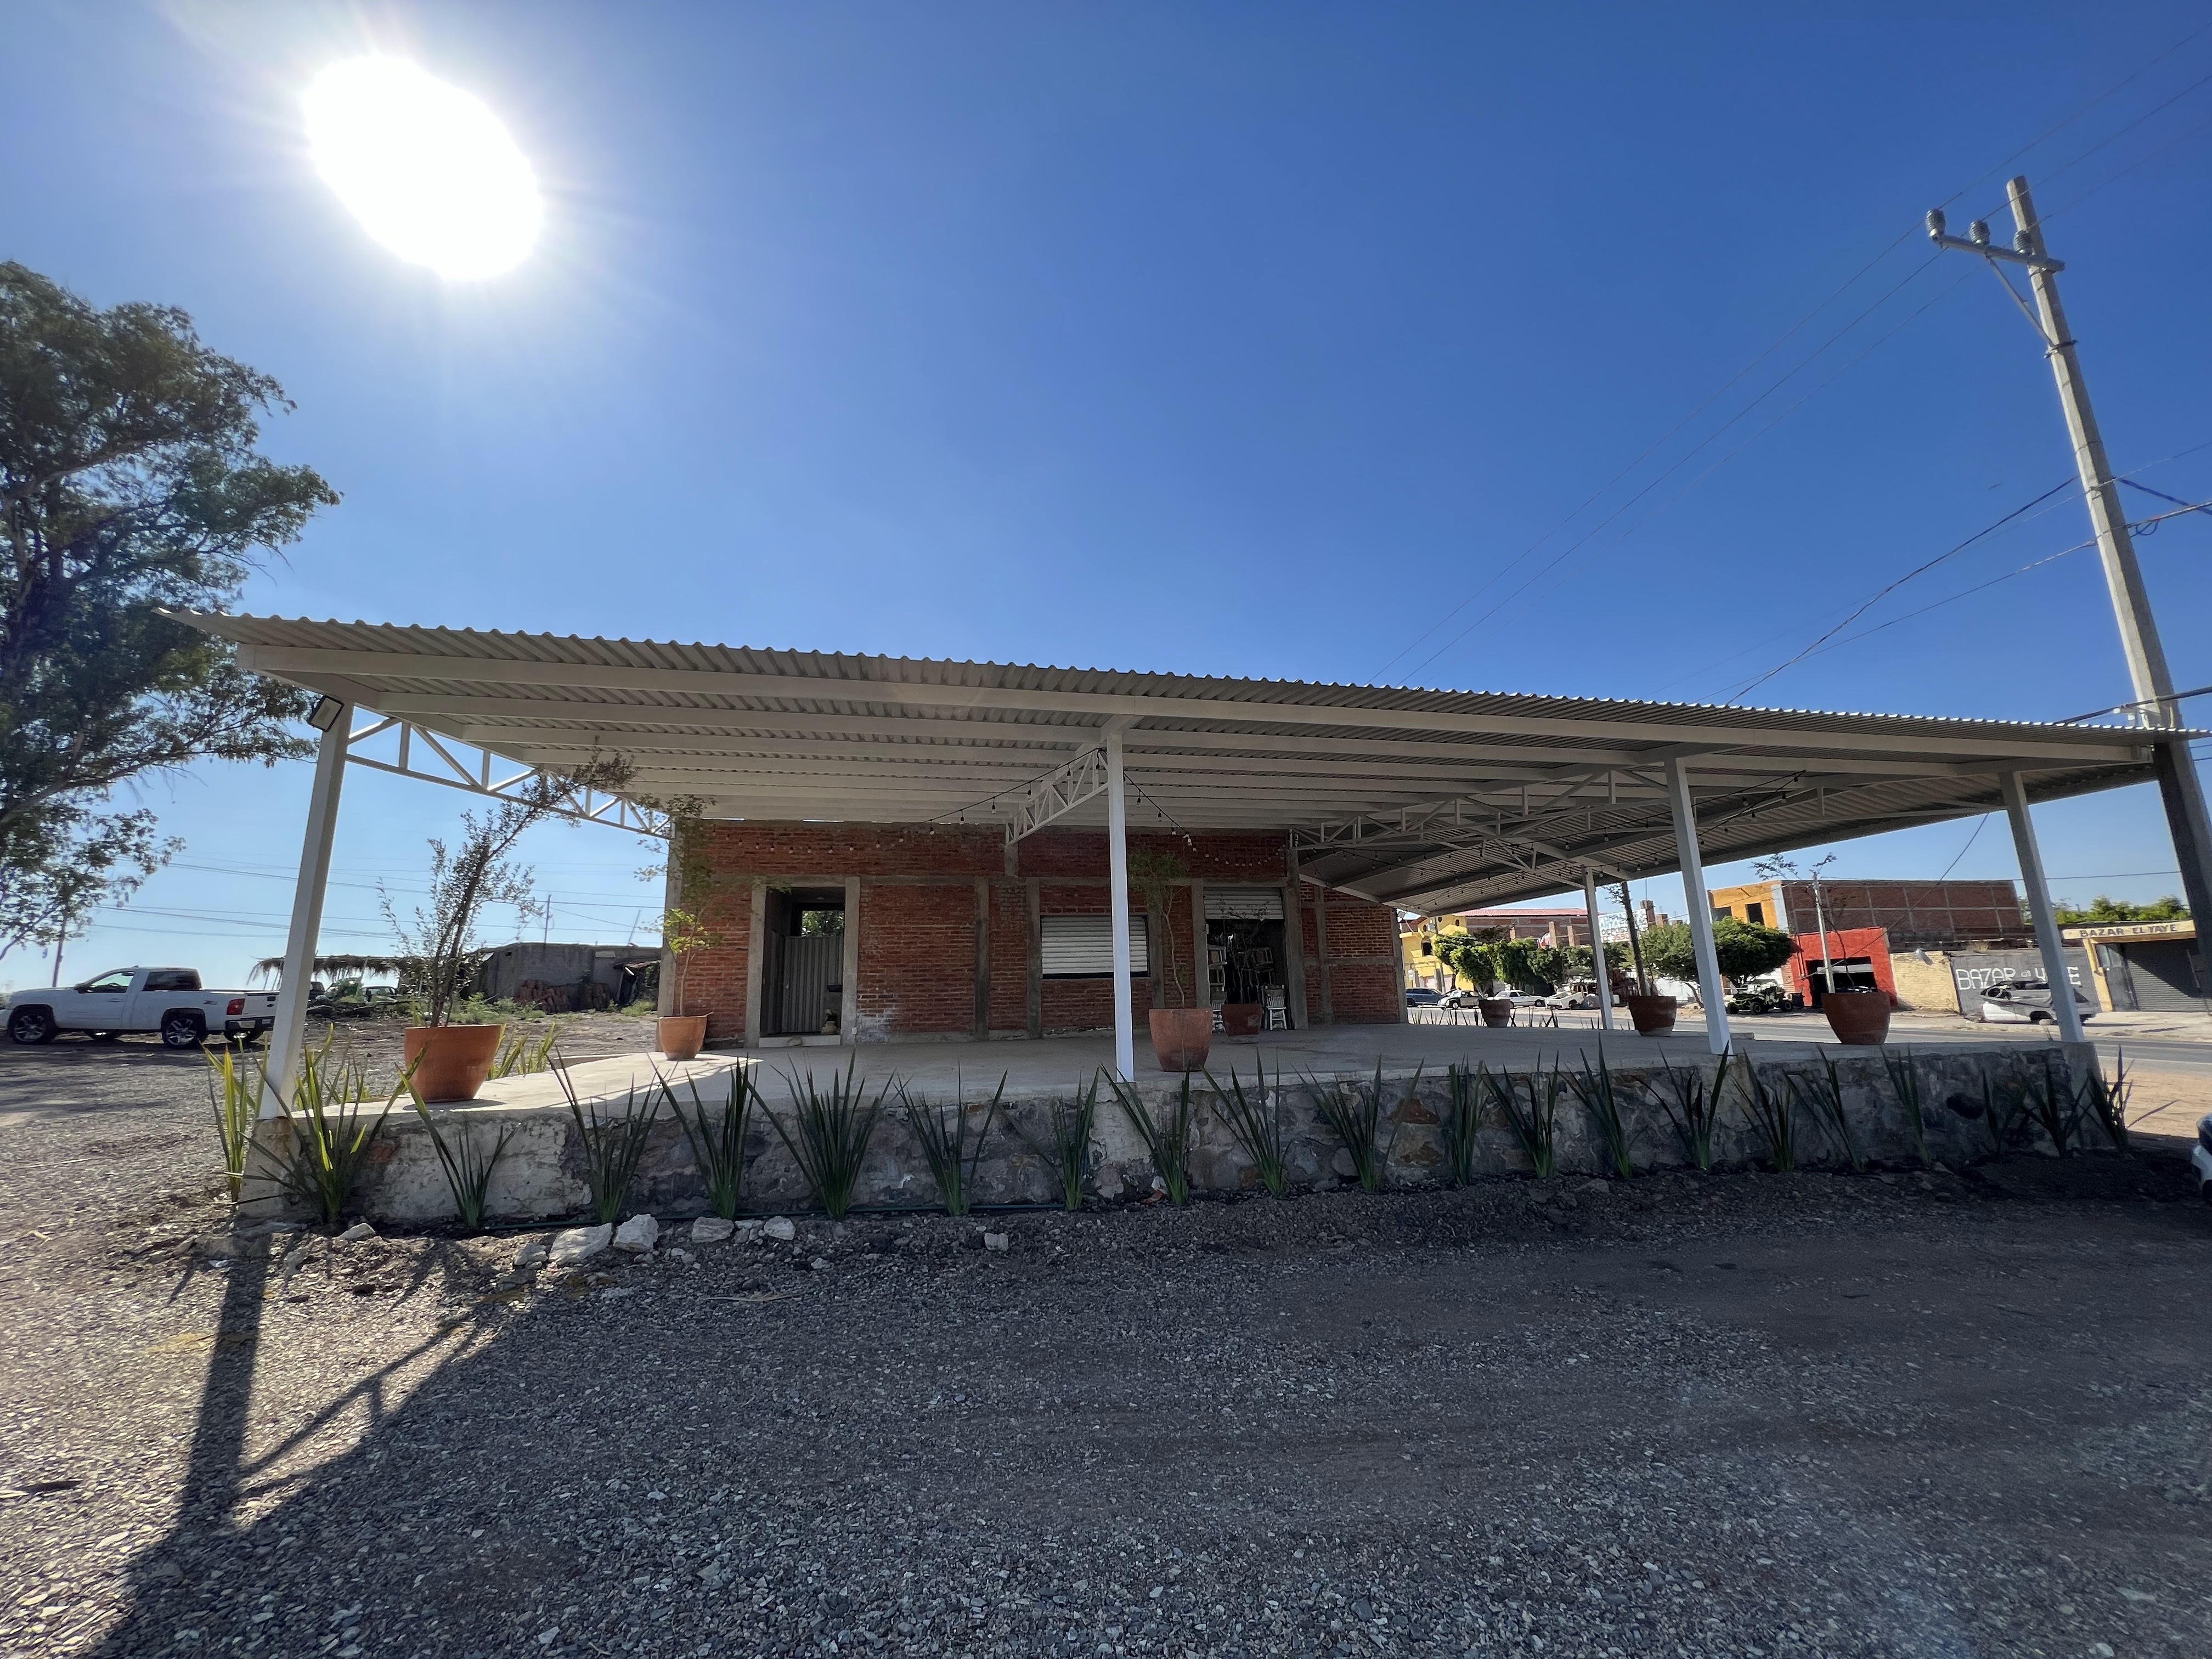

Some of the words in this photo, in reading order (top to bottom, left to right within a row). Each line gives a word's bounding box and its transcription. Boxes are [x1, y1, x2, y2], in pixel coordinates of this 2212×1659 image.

[2080, 928, 2124, 936] BAZAR
[1955, 968, 2016, 990] BAZAR
[2035, 966, 2083, 985] YE
